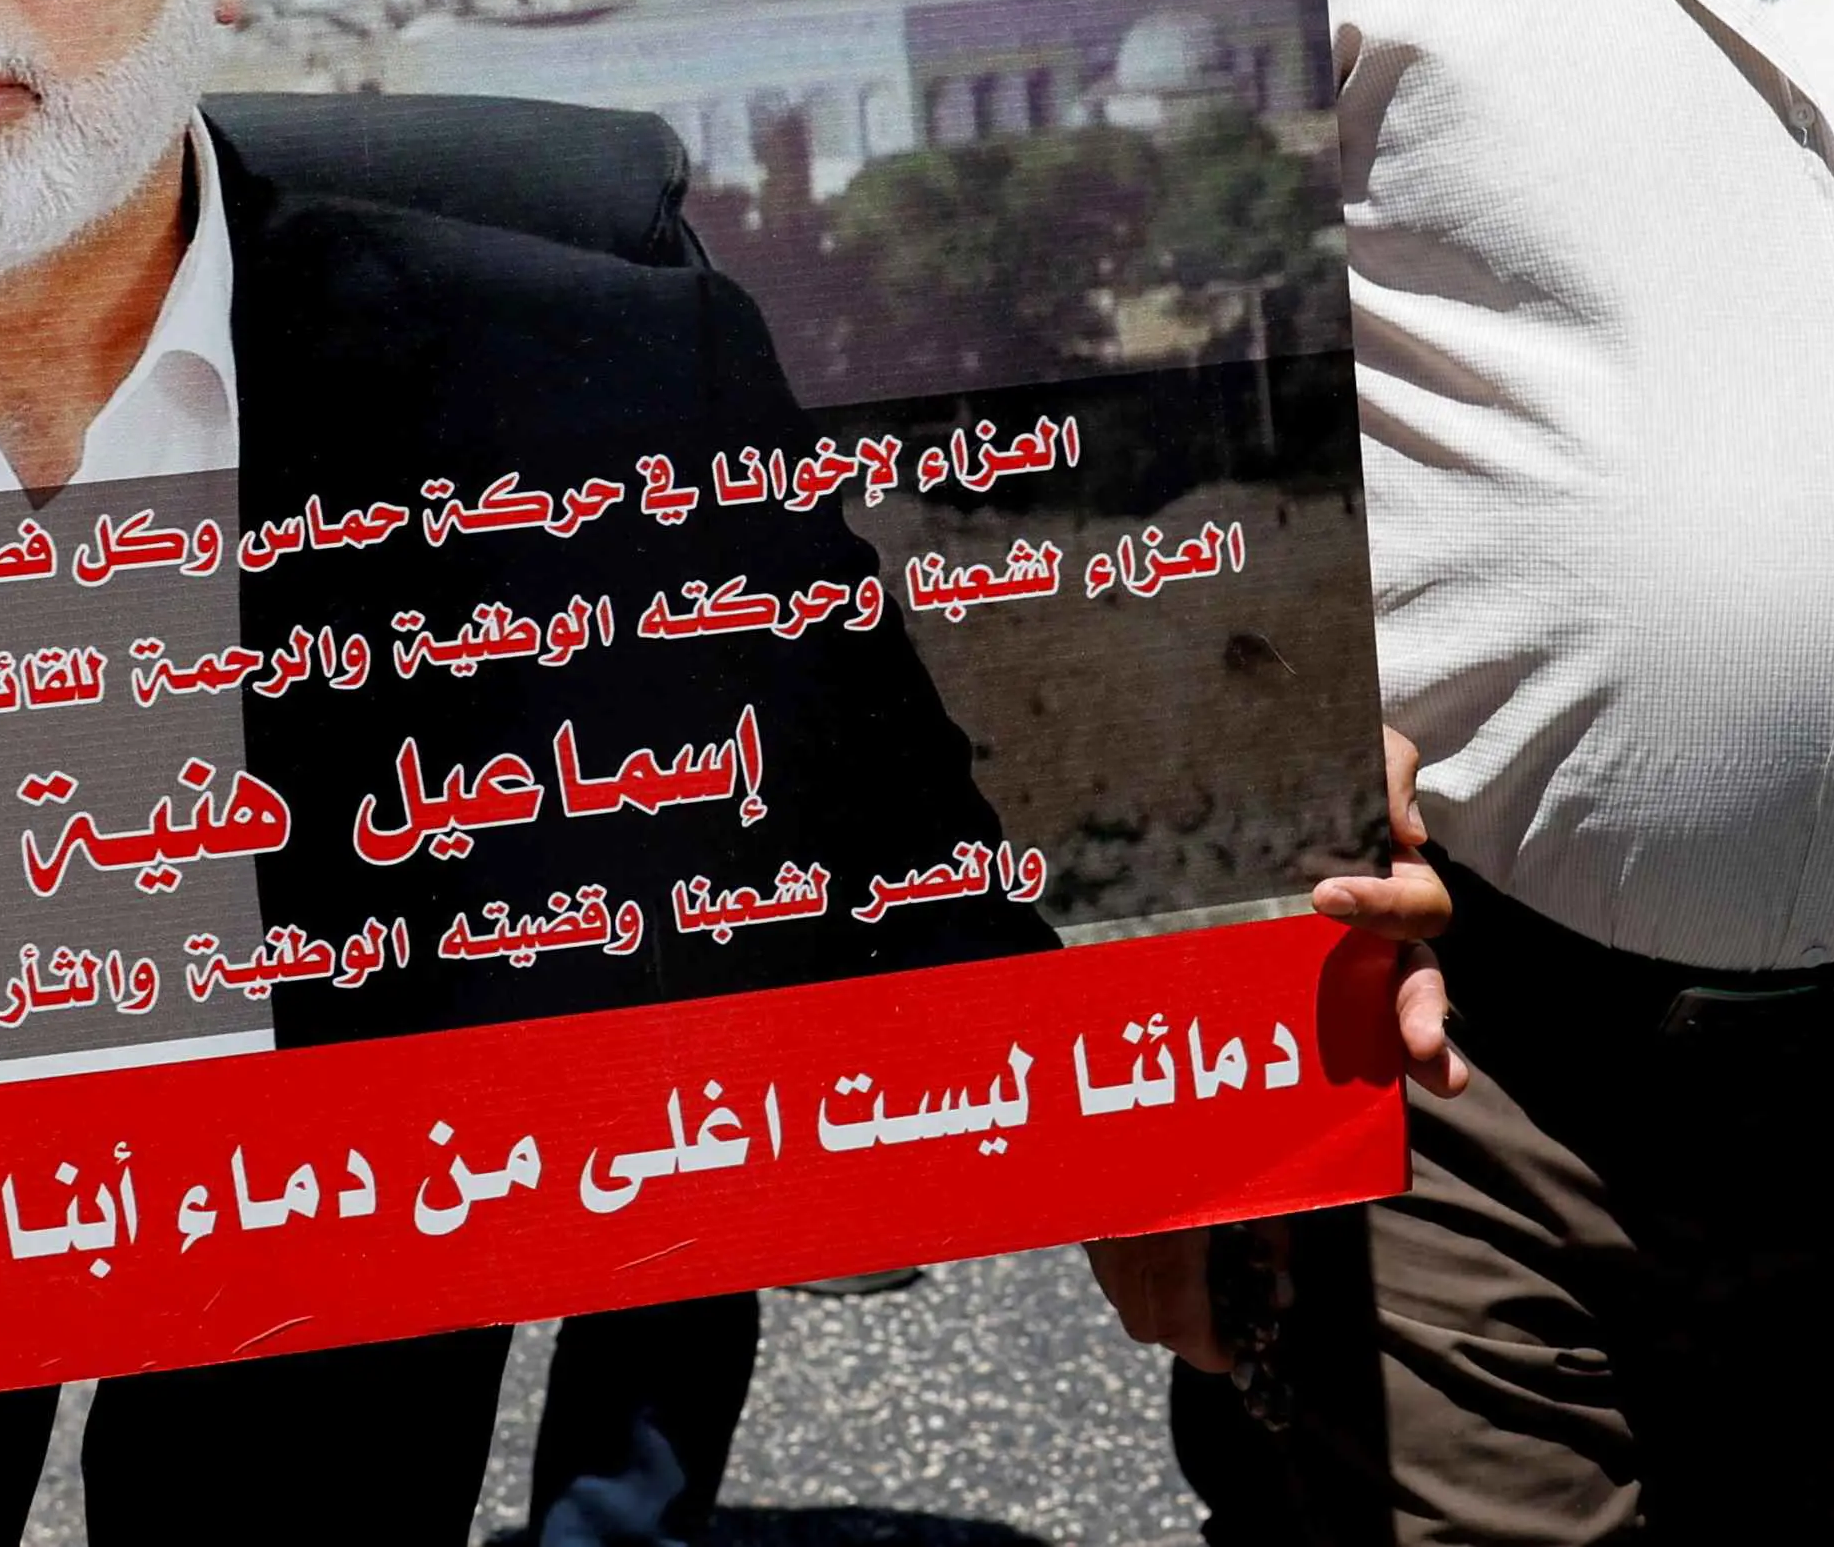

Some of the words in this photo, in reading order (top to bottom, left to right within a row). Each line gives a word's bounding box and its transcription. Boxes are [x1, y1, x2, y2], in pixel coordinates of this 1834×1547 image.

[640, 453, 699, 526] في
[917, 416, 1081, 493] العزاء
[72, 509, 223, 587] وكل
[236, 496, 410, 572] حماس
[420, 473, 625, 547] حركة
[906, 539, 1062, 622] لشعبنا
[1085, 523, 1245, 598] العزاء
[393, 595, 615, 680] الوطنية
[637, 574, 884, 641] وحركته
[129, 624, 370, 707] والرحمة
[18, 757, 291, 896] هنية
[353, 704, 767, 865] إسماعيل
[672, 861, 831, 945] لشعبنا
[853, 841, 1047, 923] والنصر
[185, 917, 410, 1002] الوطنية
[438, 884, 645, 970] وقضيته
[815, 1041, 1034, 1159] ليست
[1073, 1011, 1302, 1118] دمائنا
[414, 1118, 542, 1237] من
[579, 1079, 782, 1215] اغلى
[177, 1144, 376, 1255] دماء
